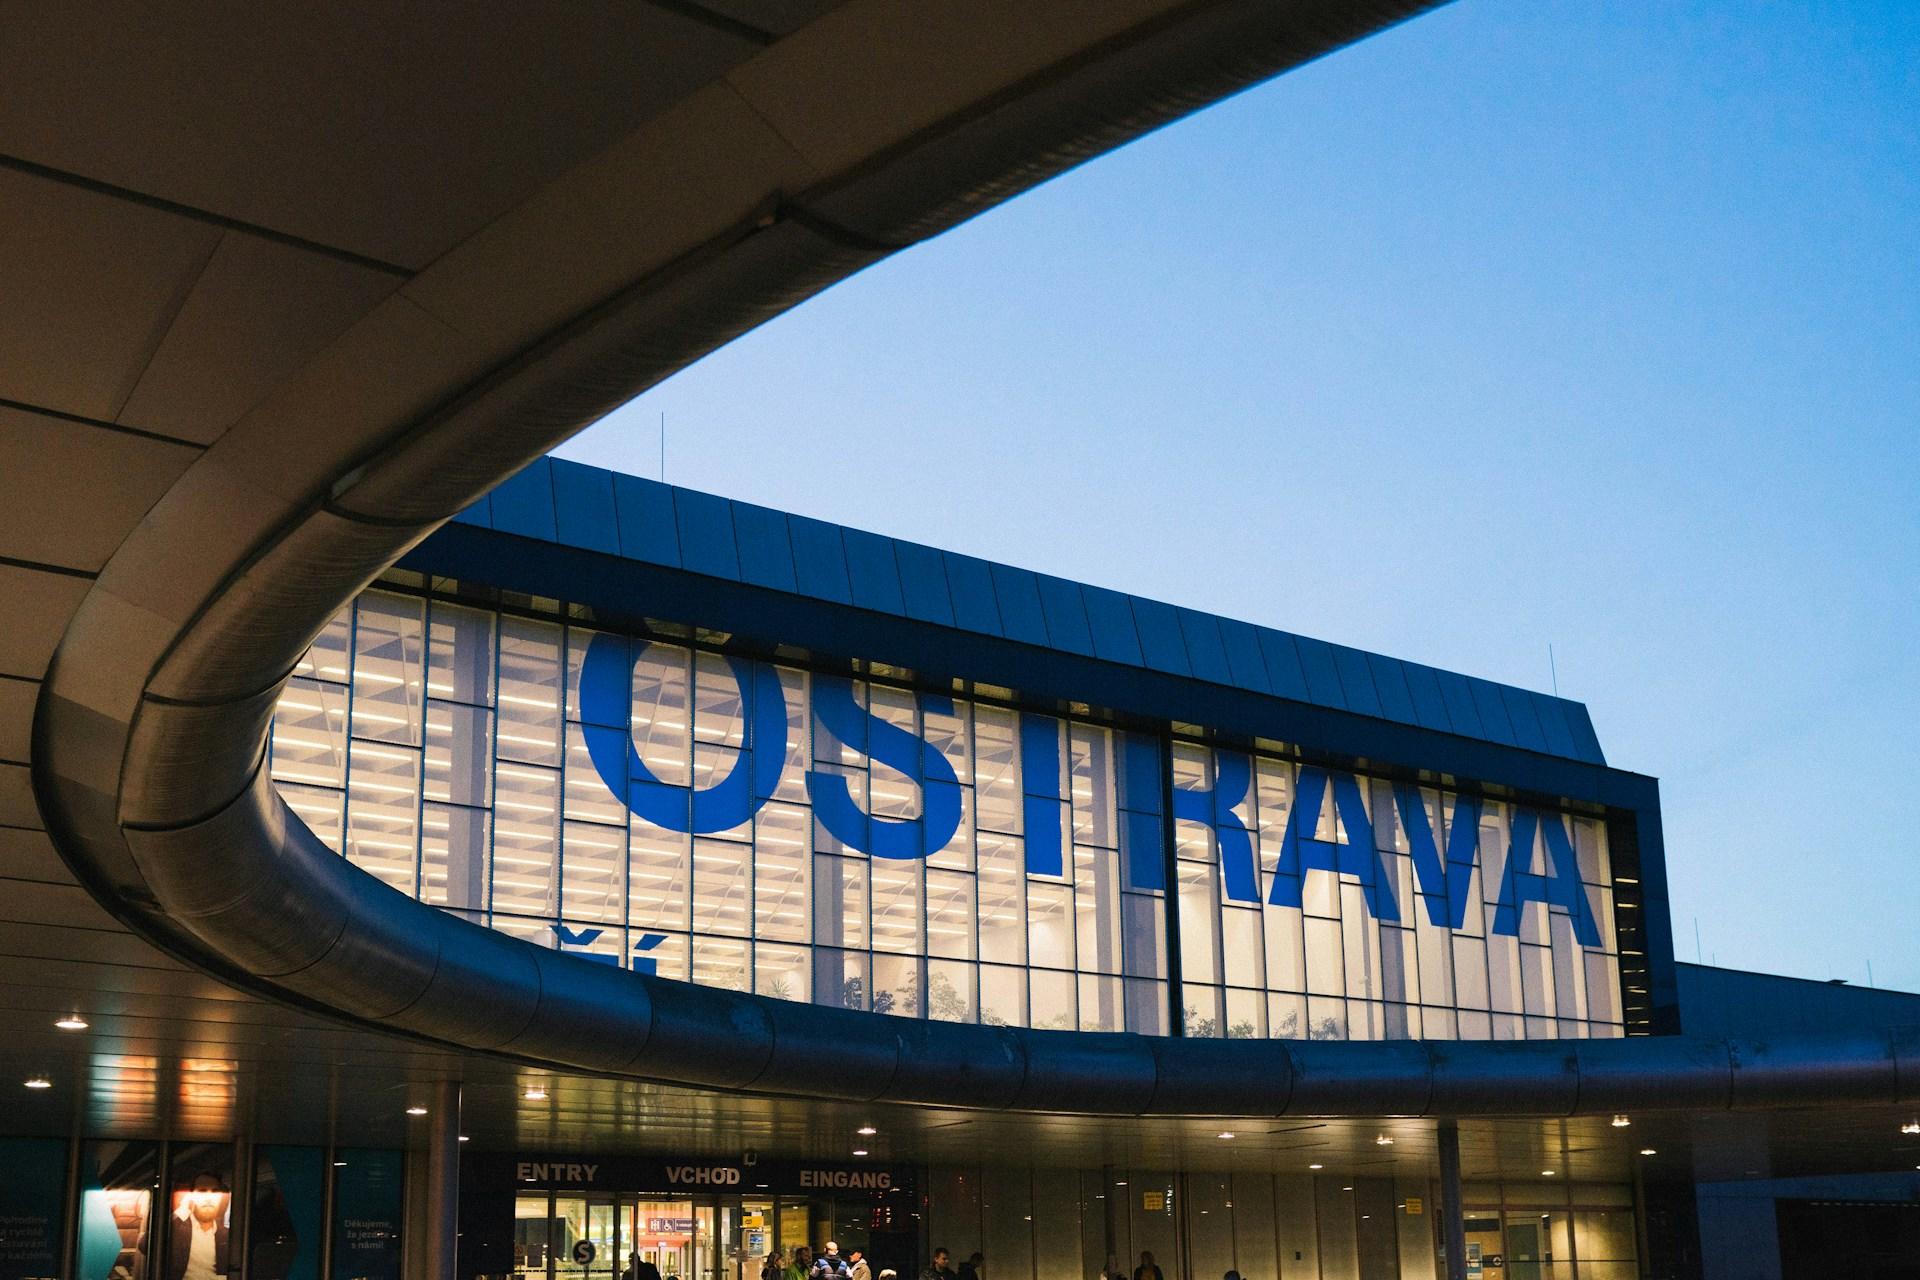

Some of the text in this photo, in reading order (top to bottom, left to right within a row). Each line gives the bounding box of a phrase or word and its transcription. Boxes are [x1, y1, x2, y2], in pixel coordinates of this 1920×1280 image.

[579, 631, 1603, 948] OSTRAVA
[516, 1162, 598, 1182] ENTRY
[665, 1166, 741, 1185] VCHOD
[800, 1170, 891, 1189] EINGANG
